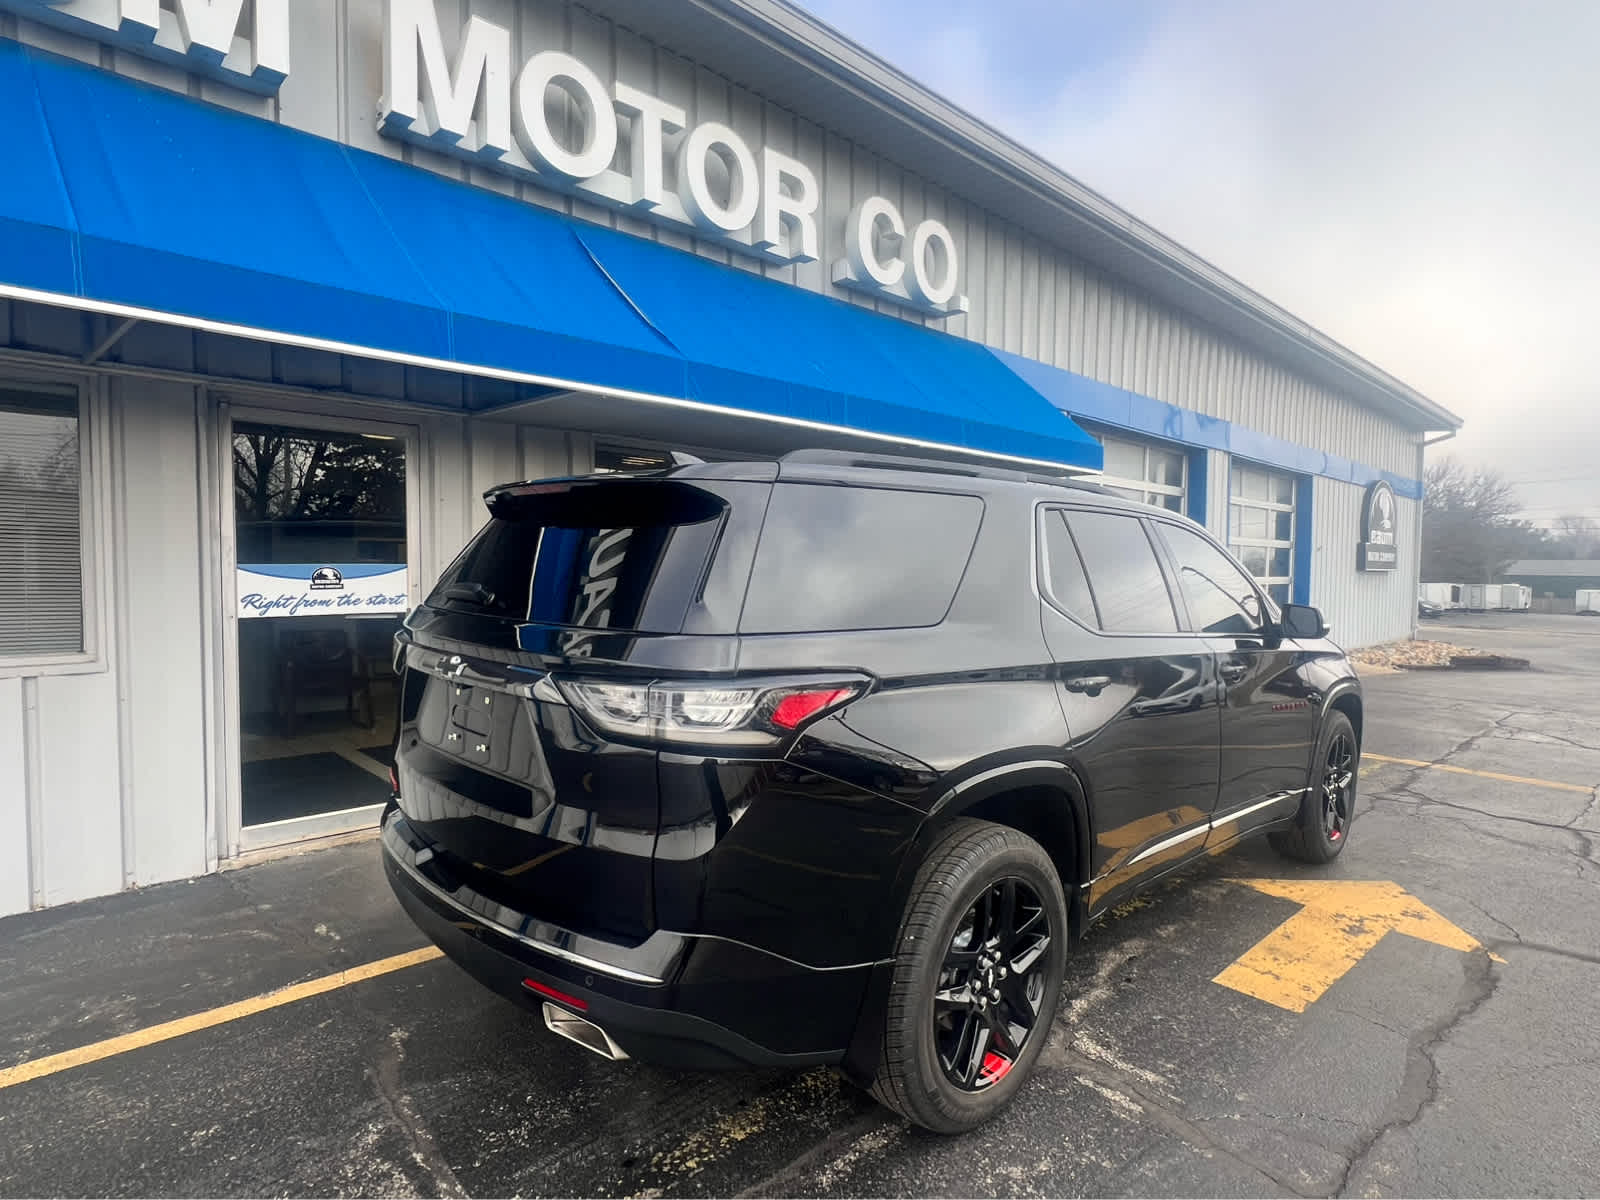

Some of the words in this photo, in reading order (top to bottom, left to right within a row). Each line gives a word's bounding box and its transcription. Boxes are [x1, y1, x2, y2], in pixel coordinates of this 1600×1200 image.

[387, 0, 819, 262] MOTOR
[241, 593, 298, 616] Right
[289, 593, 336, 615] from
[336, 592, 364, 606] the
